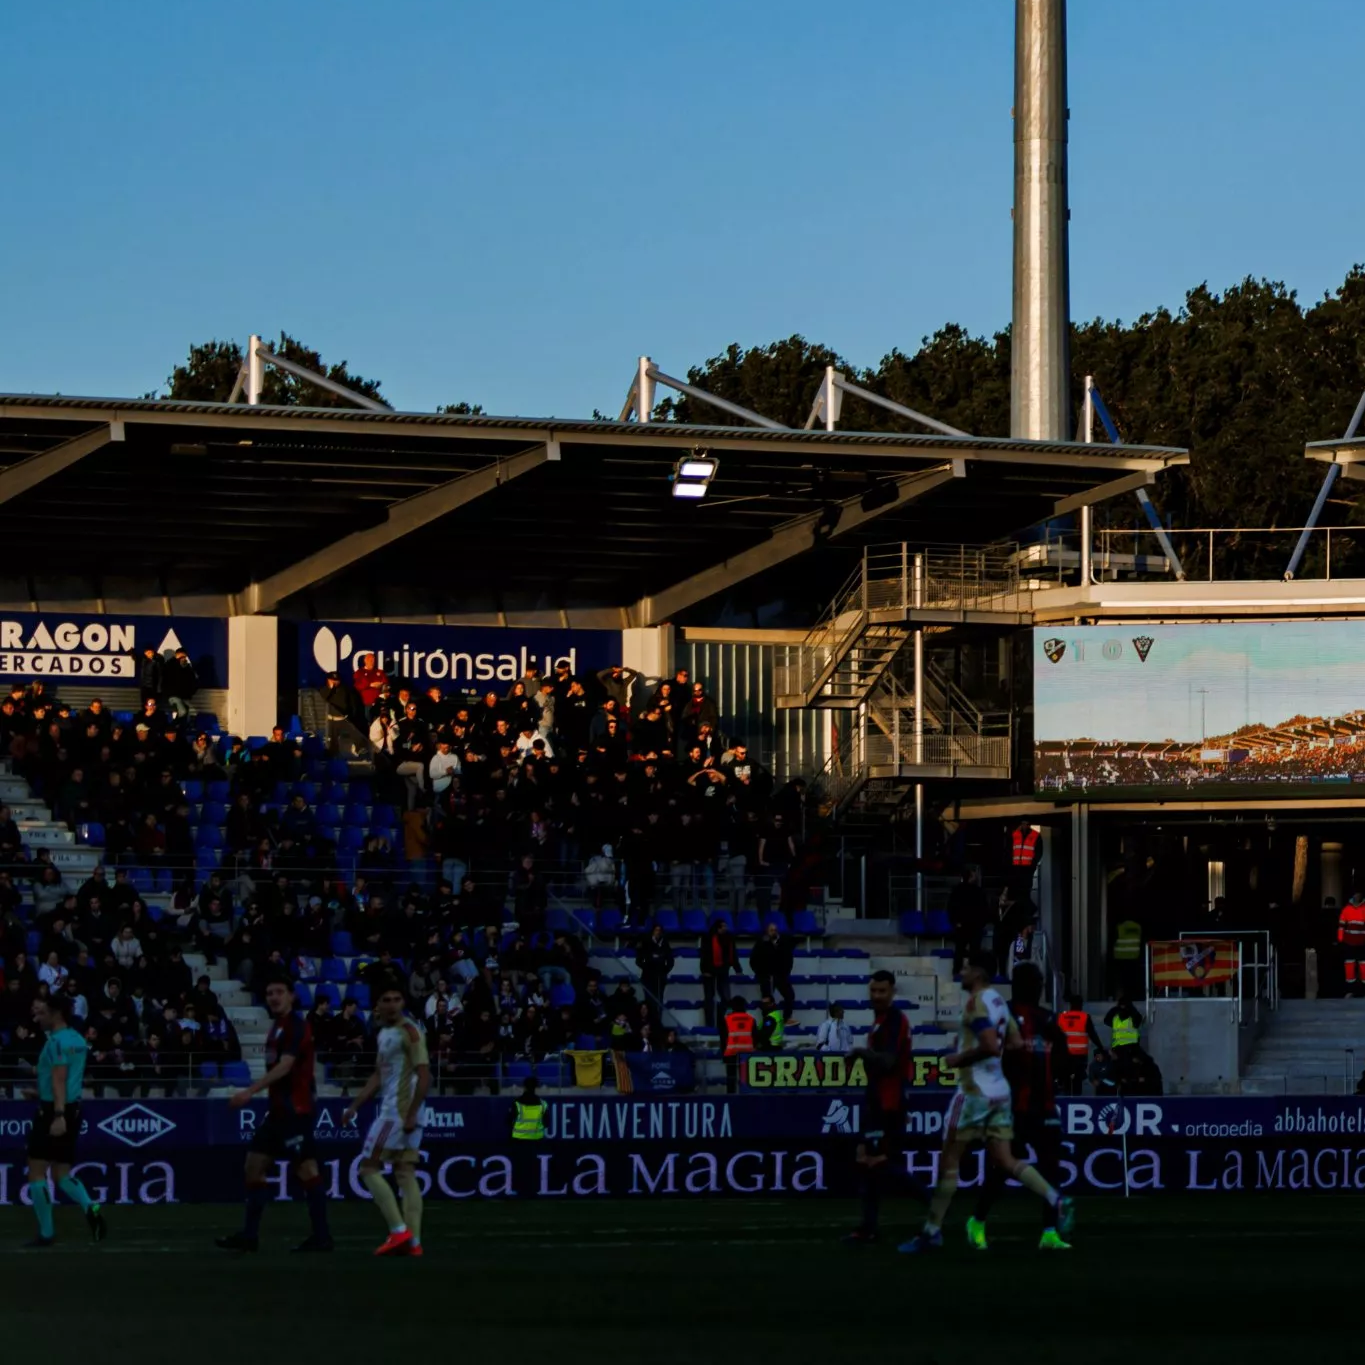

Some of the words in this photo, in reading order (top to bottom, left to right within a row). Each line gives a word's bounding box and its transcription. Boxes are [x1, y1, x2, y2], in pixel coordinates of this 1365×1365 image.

[748, 1055, 869, 1088] GRADA
[112, 1118, 163, 1133] KUHN
[544, 1101, 733, 1139] UENAVENTURA
[1185, 1120, 1263, 1137] ortopedia
